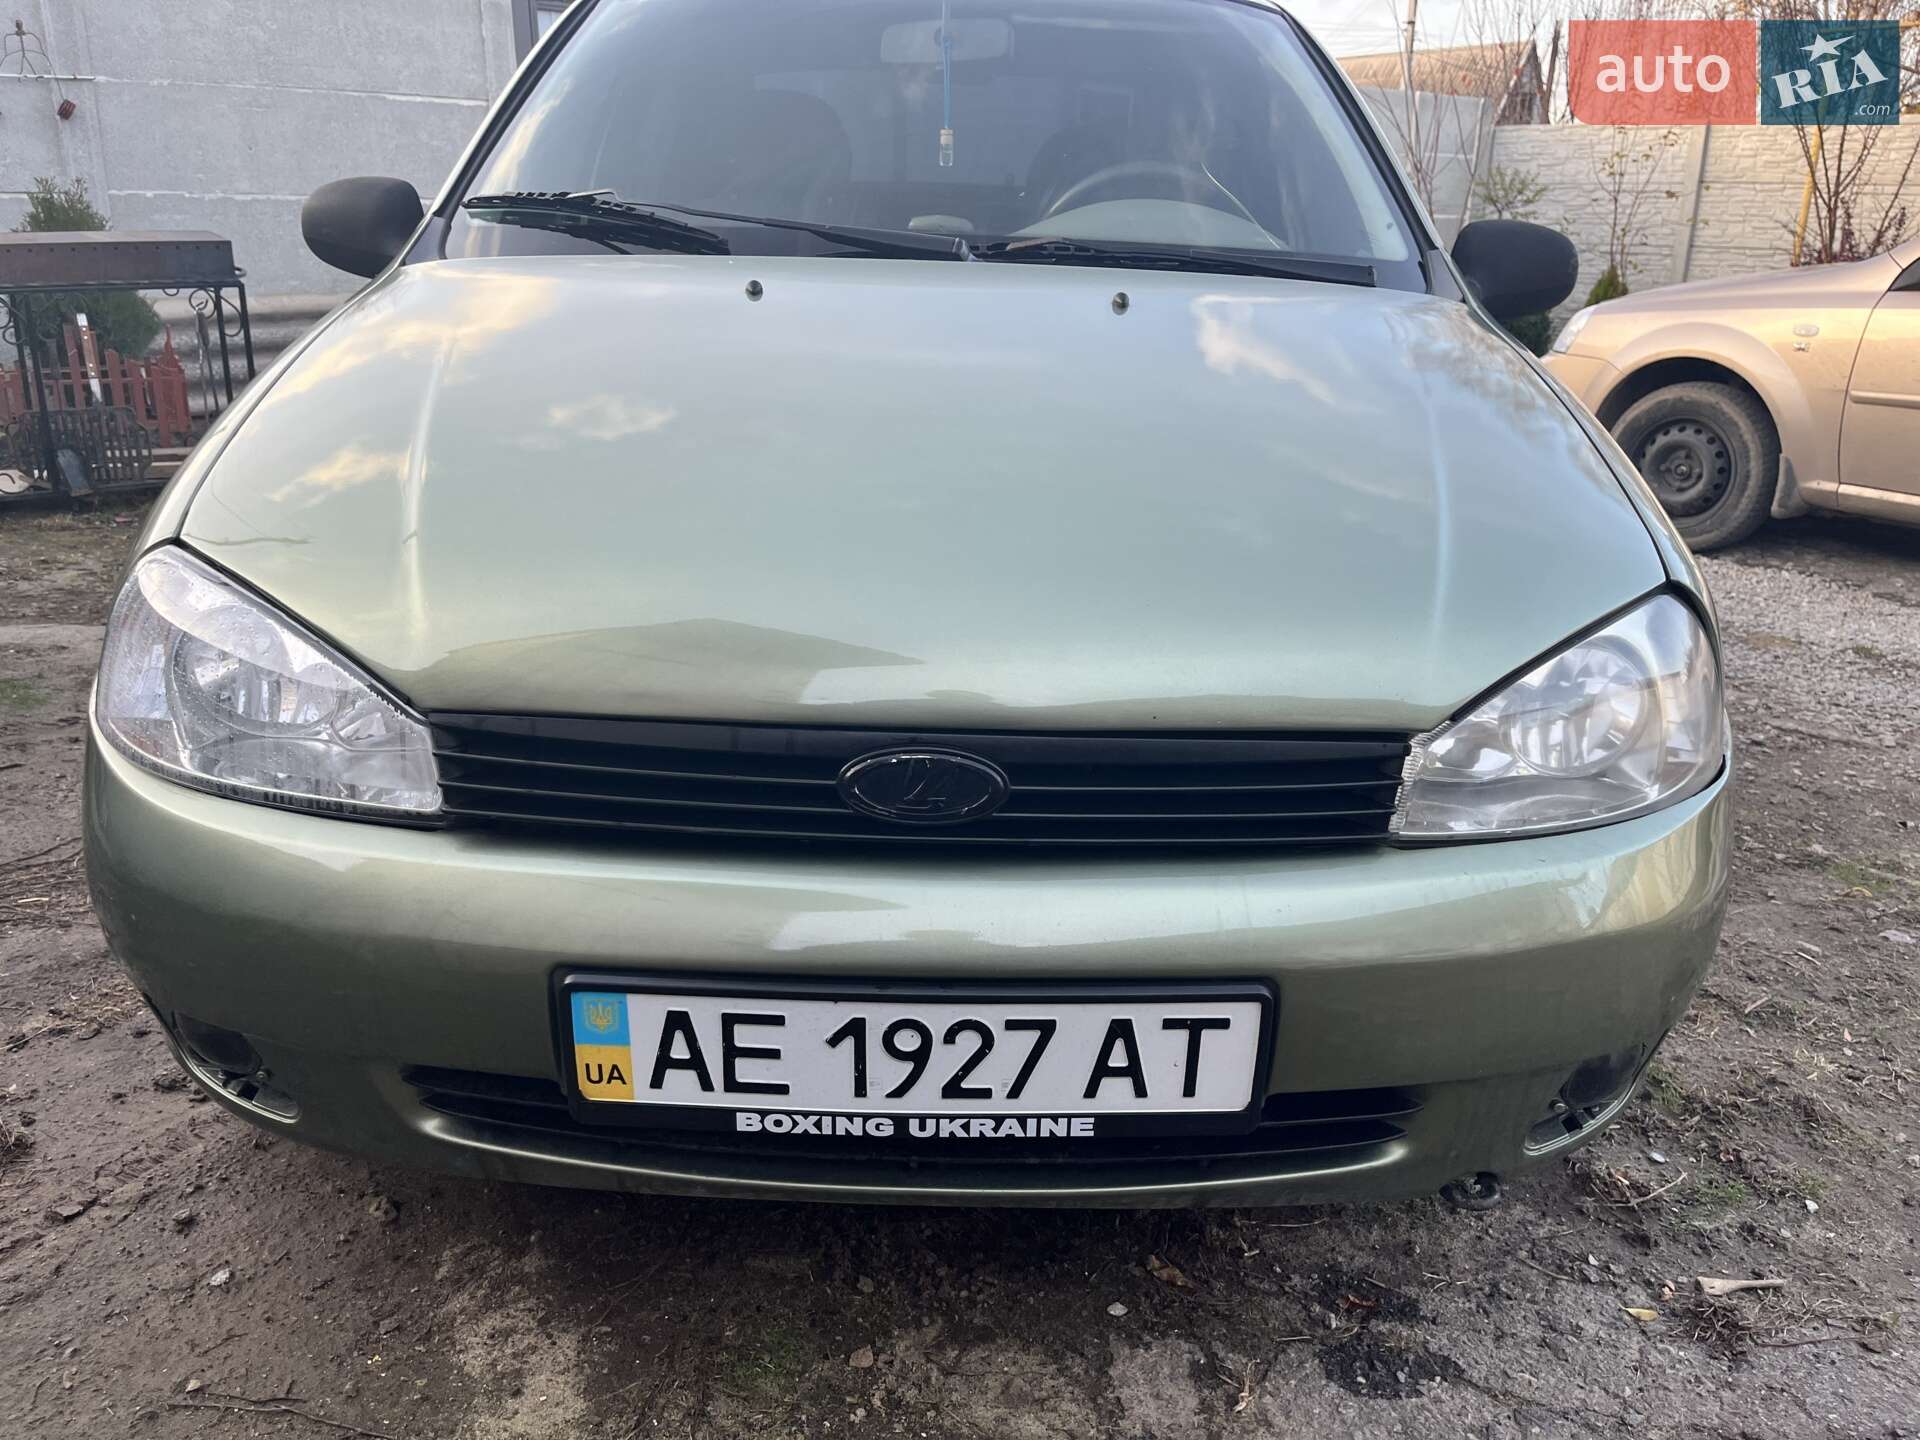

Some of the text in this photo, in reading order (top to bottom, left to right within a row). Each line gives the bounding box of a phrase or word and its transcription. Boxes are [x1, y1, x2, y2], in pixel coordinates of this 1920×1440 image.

[649, 1010, 1231, 1099] AE 1927 AT
[585, 1062, 627, 1085] UA
[735, 1112, 1095, 1138] BOXING UKRAINE
